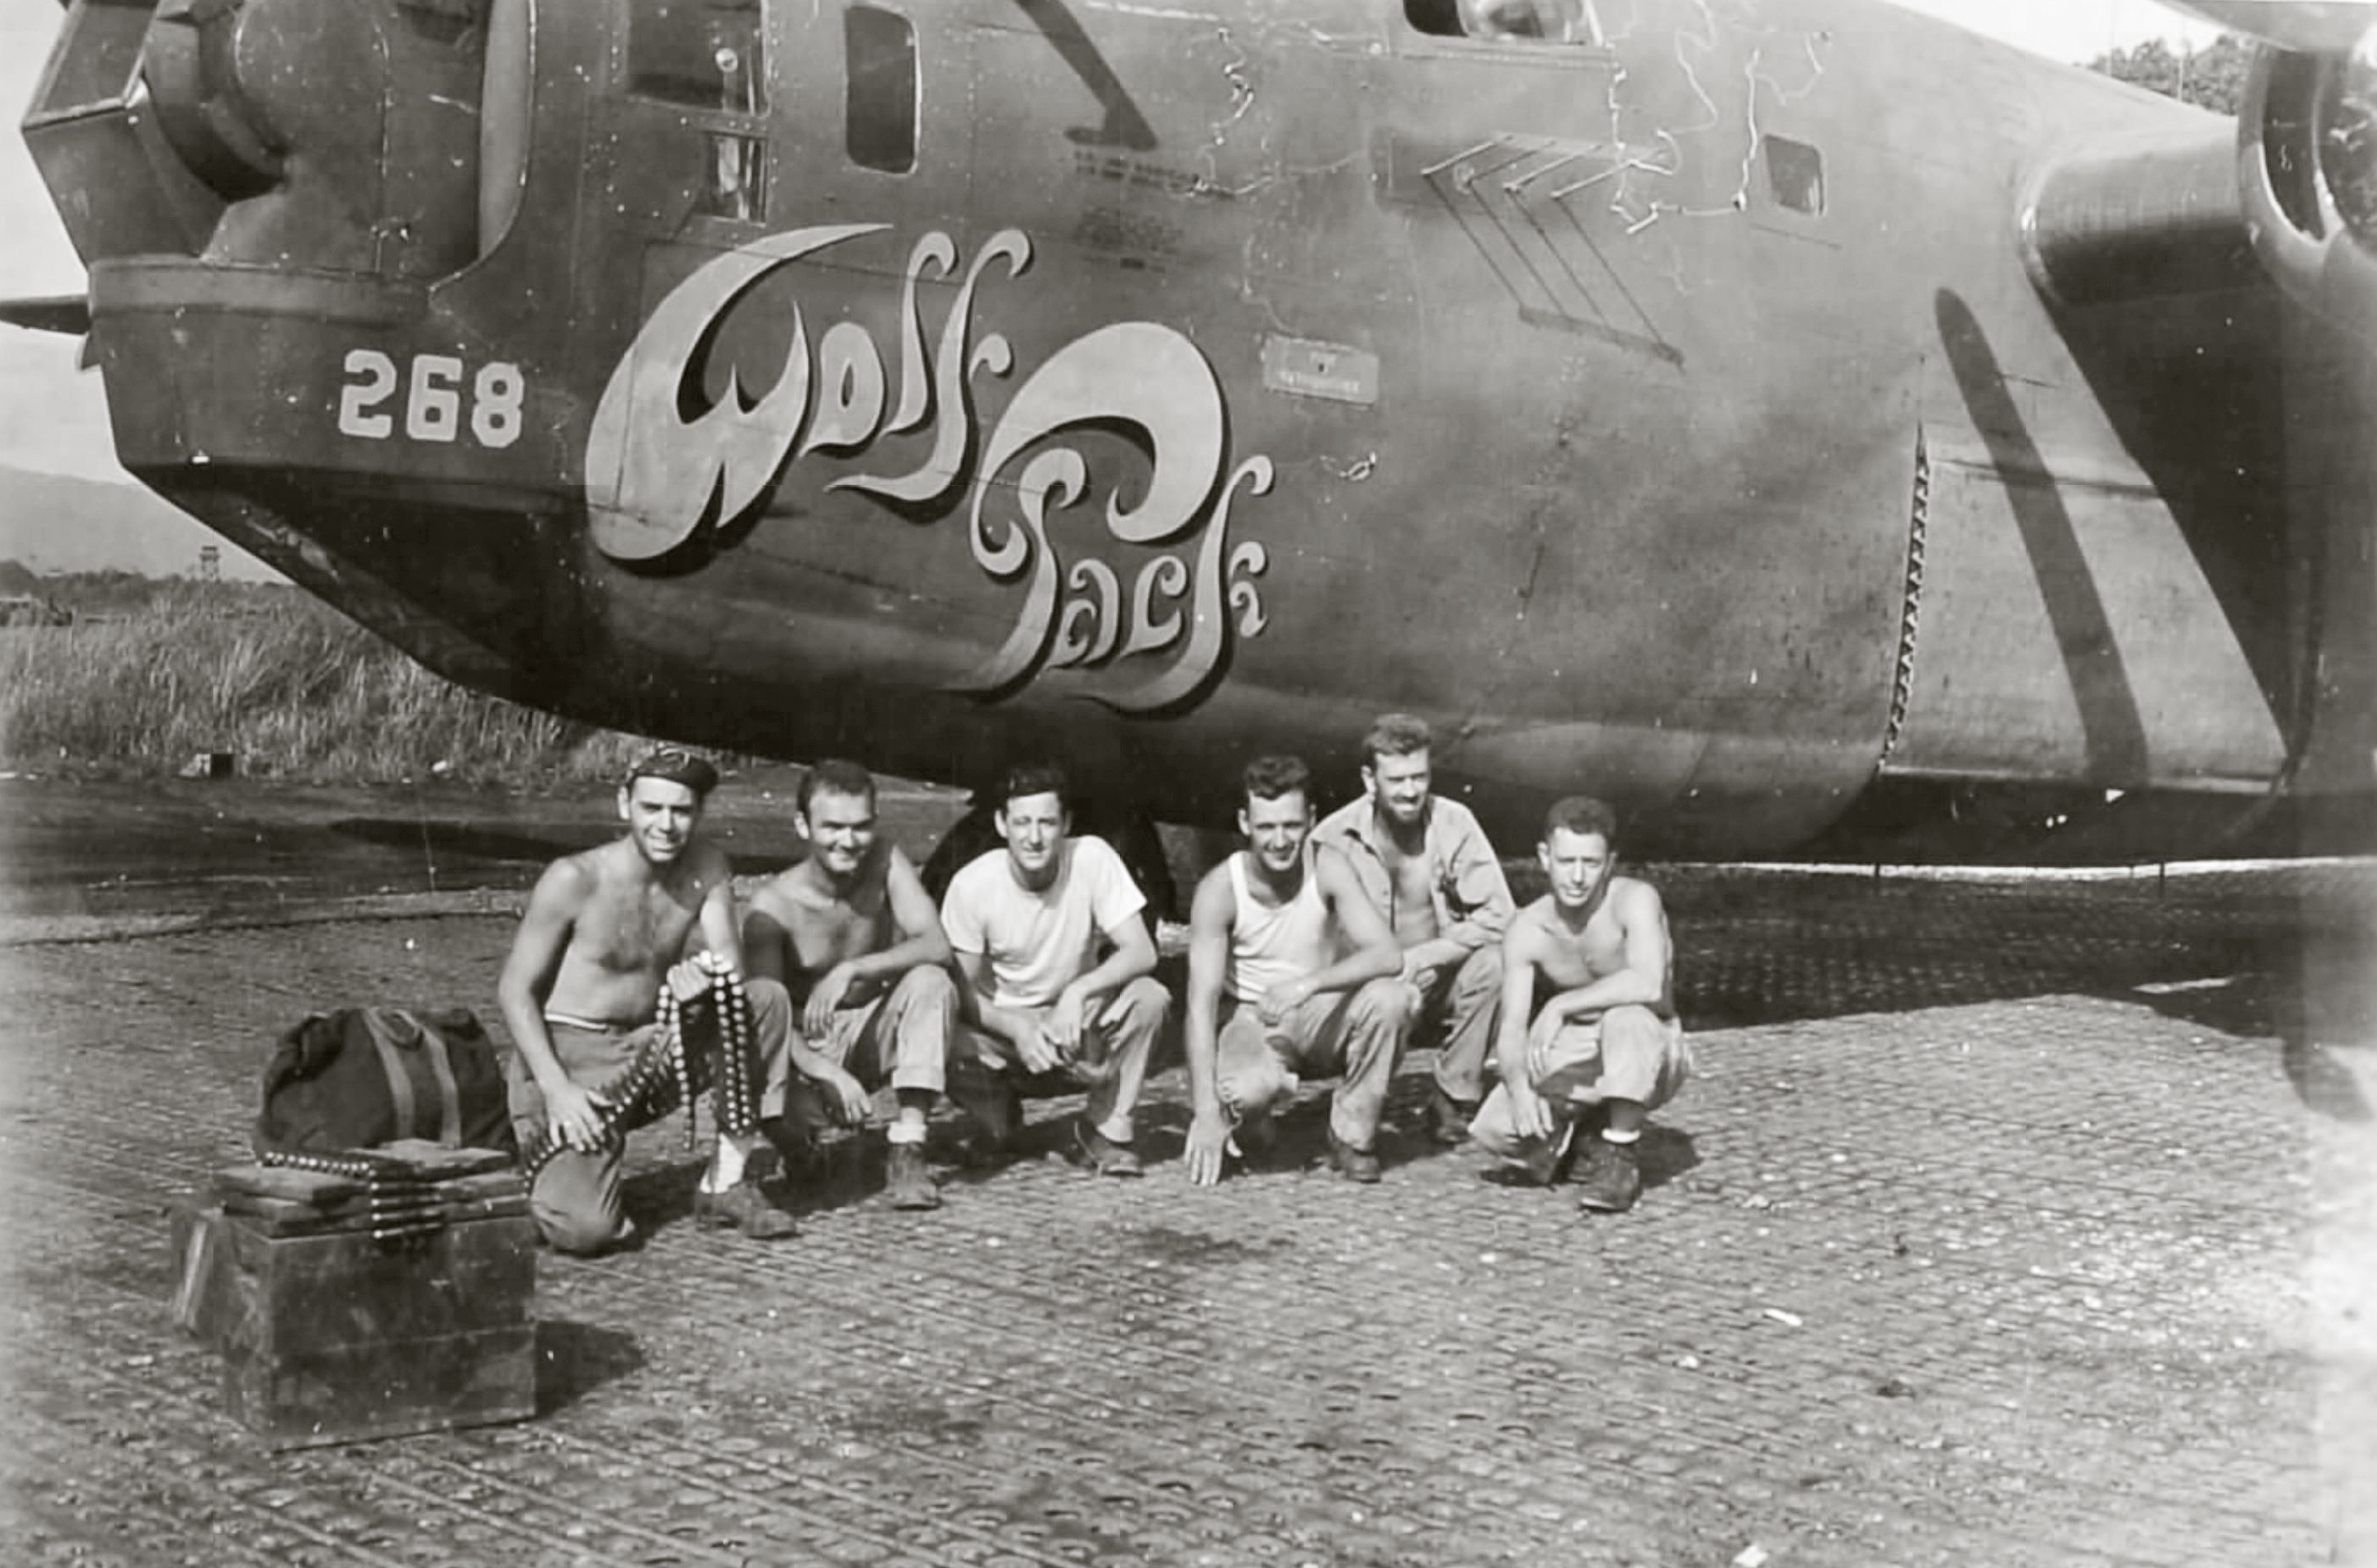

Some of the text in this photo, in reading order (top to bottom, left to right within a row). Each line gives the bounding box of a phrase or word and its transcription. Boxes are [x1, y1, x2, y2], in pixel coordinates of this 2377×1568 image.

[339, 348, 524, 448] 268
[585, 222, 1031, 559] Wolf
[939, 320, 1274, 710] Pack
